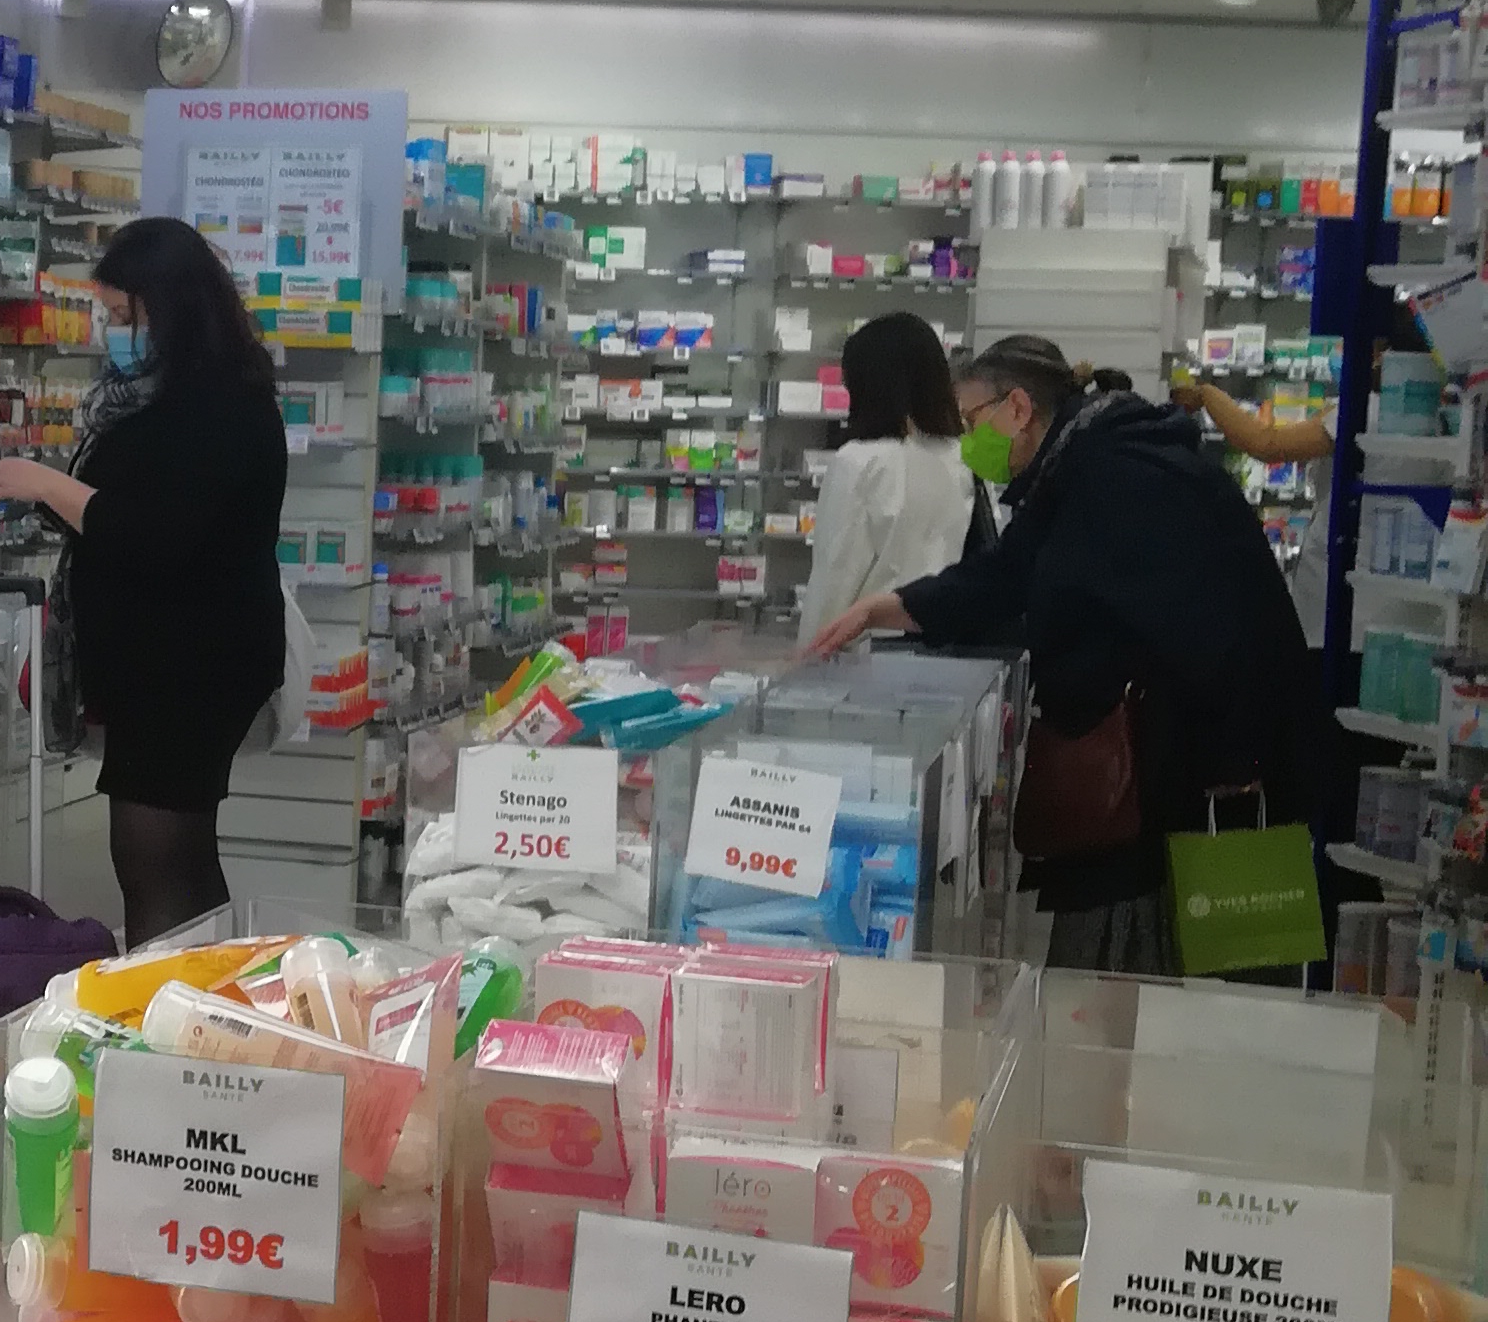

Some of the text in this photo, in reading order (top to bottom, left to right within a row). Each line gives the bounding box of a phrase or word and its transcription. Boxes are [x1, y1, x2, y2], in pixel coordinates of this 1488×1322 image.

[179, 101, 369, 121] NOS PROMOTIONS
[499, 789, 568, 811] Stenago
[729, 794, 800, 819] ASSANIS
[493, 831, 571, 860] 2,50€
[725, 846, 798, 879] 9,99€
[182, 1070, 264, 1093] BAILLY
[185, 1128, 247, 1155] MKL
[112, 1148, 319, 1188] SHAMPOOING DOUCHE
[183, 1177, 242, 1198] 200ML
[715, 1168, 772, 1199] léro
[1197, 1189, 1299, 1216] BAILLY
[158, 1220, 284, 1269] 1,99€
[666, 1240, 757, 1268] BAILLY
[1184, 1248, 1283, 1283] NUXE
[670, 1286, 746, 1315] LERO
[1127, 1274, 1338, 1317] HUILE DE DOUCHE
